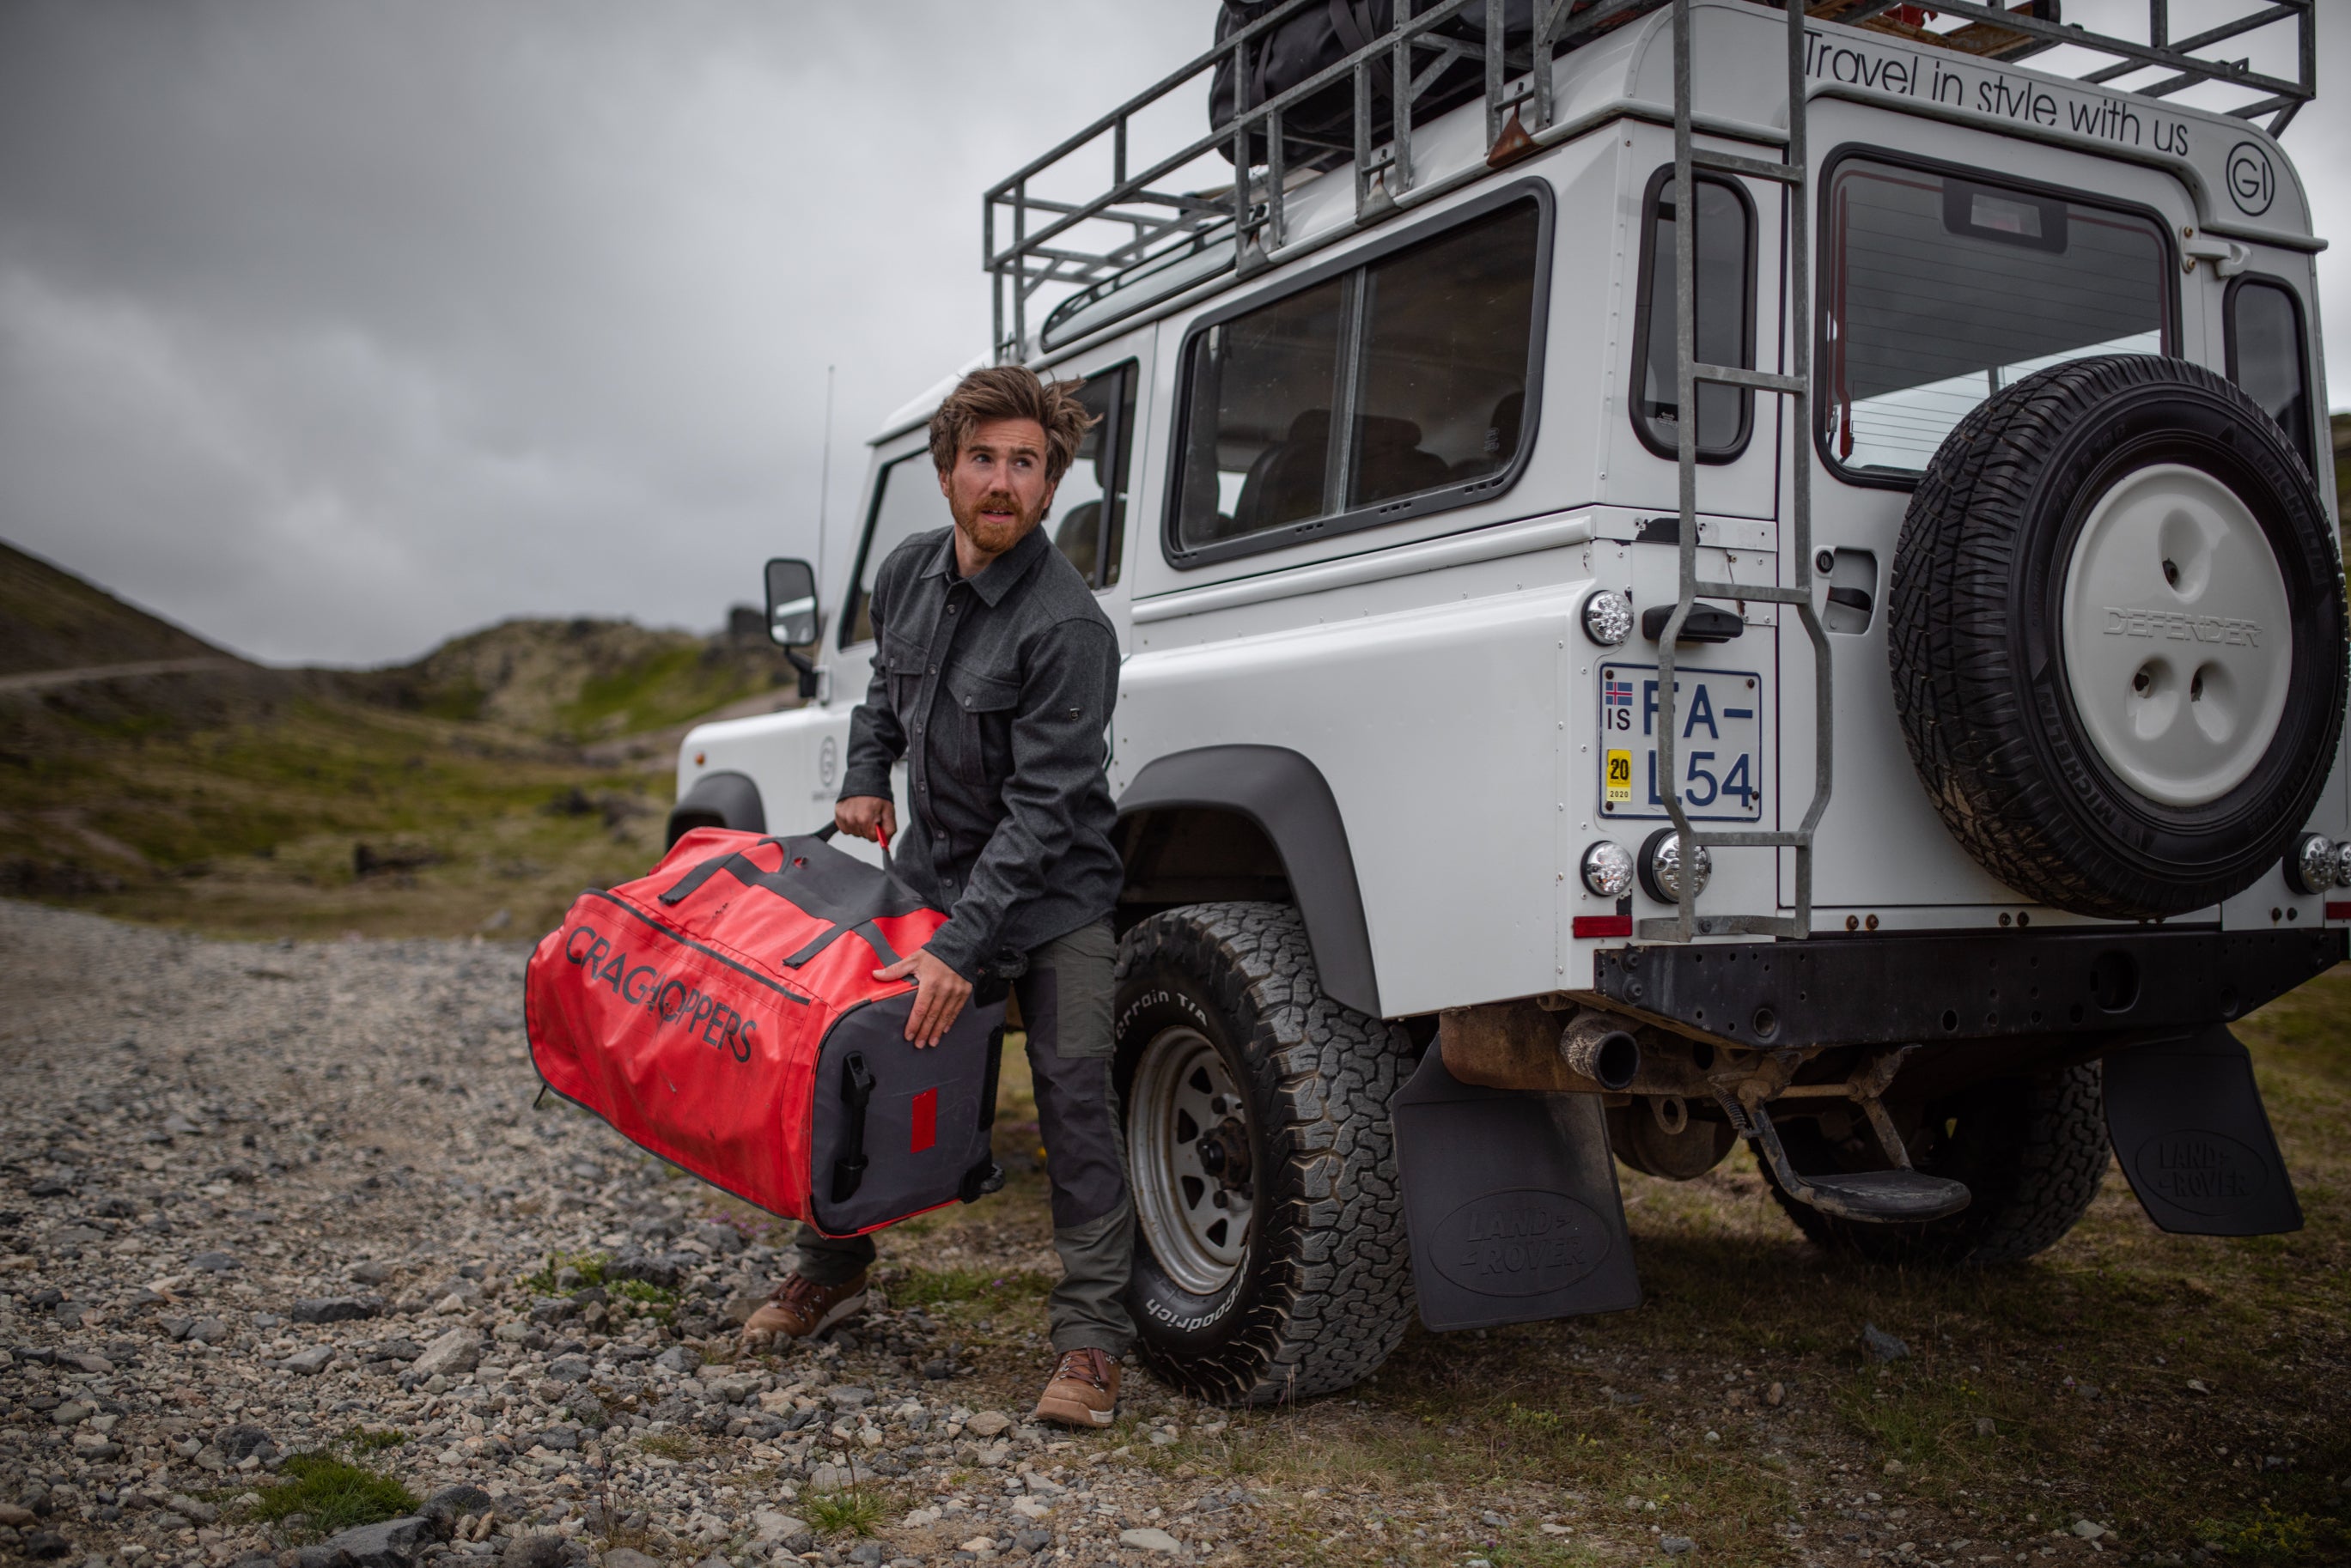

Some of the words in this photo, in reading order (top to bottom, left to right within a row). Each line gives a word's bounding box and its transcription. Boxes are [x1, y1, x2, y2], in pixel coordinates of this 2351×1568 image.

[1804, 30, 1919, 95] Travel
[1932, 60, 1963, 106] in
[2068, 99, 2141, 145] with
[2153, 120, 2190, 156] us
[2102, 605, 2264, 647] DEFENDER
[1607, 708, 1630, 730] IS
[1611, 758, 1629, 780] 20
[1648, 749, 1753, 807] L54
[1116, 988, 1170, 1040] errain
[2159, 1140, 2217, 1170] LAND
[2171, 1169, 2251, 1198] ROVER
[1464, 1206, 1553, 1243] LAND
[1477, 1235, 1587, 1276] ROVER
